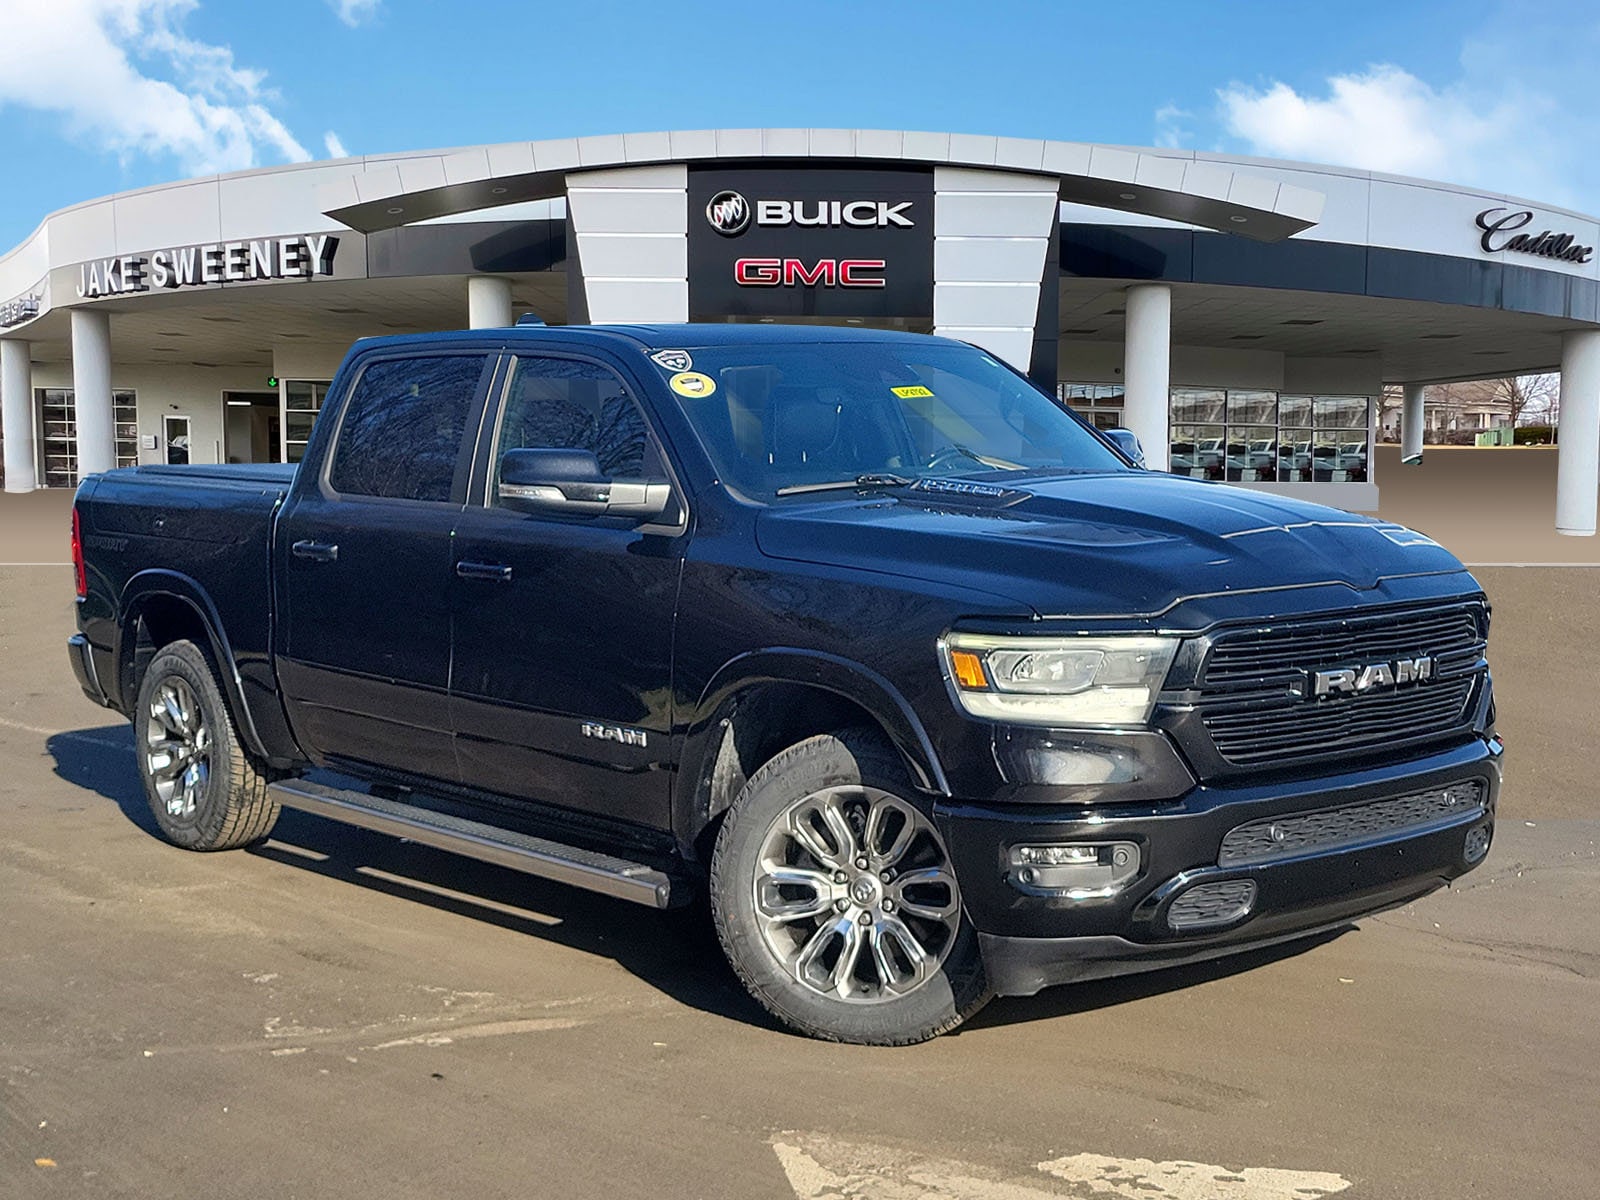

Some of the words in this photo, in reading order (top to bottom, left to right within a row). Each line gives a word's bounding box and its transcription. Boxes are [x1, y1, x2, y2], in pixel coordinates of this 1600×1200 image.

[757, 200, 915, 227] BUICK
[1475, 207, 1593, 264] Cadillac
[76, 255, 145, 299] JAKE
[151, 235, 336, 288] SWEENEY
[735, 258, 886, 287] GMC
[1314, 656, 1432, 696] RAM
[581, 722, 647, 747] RAM
